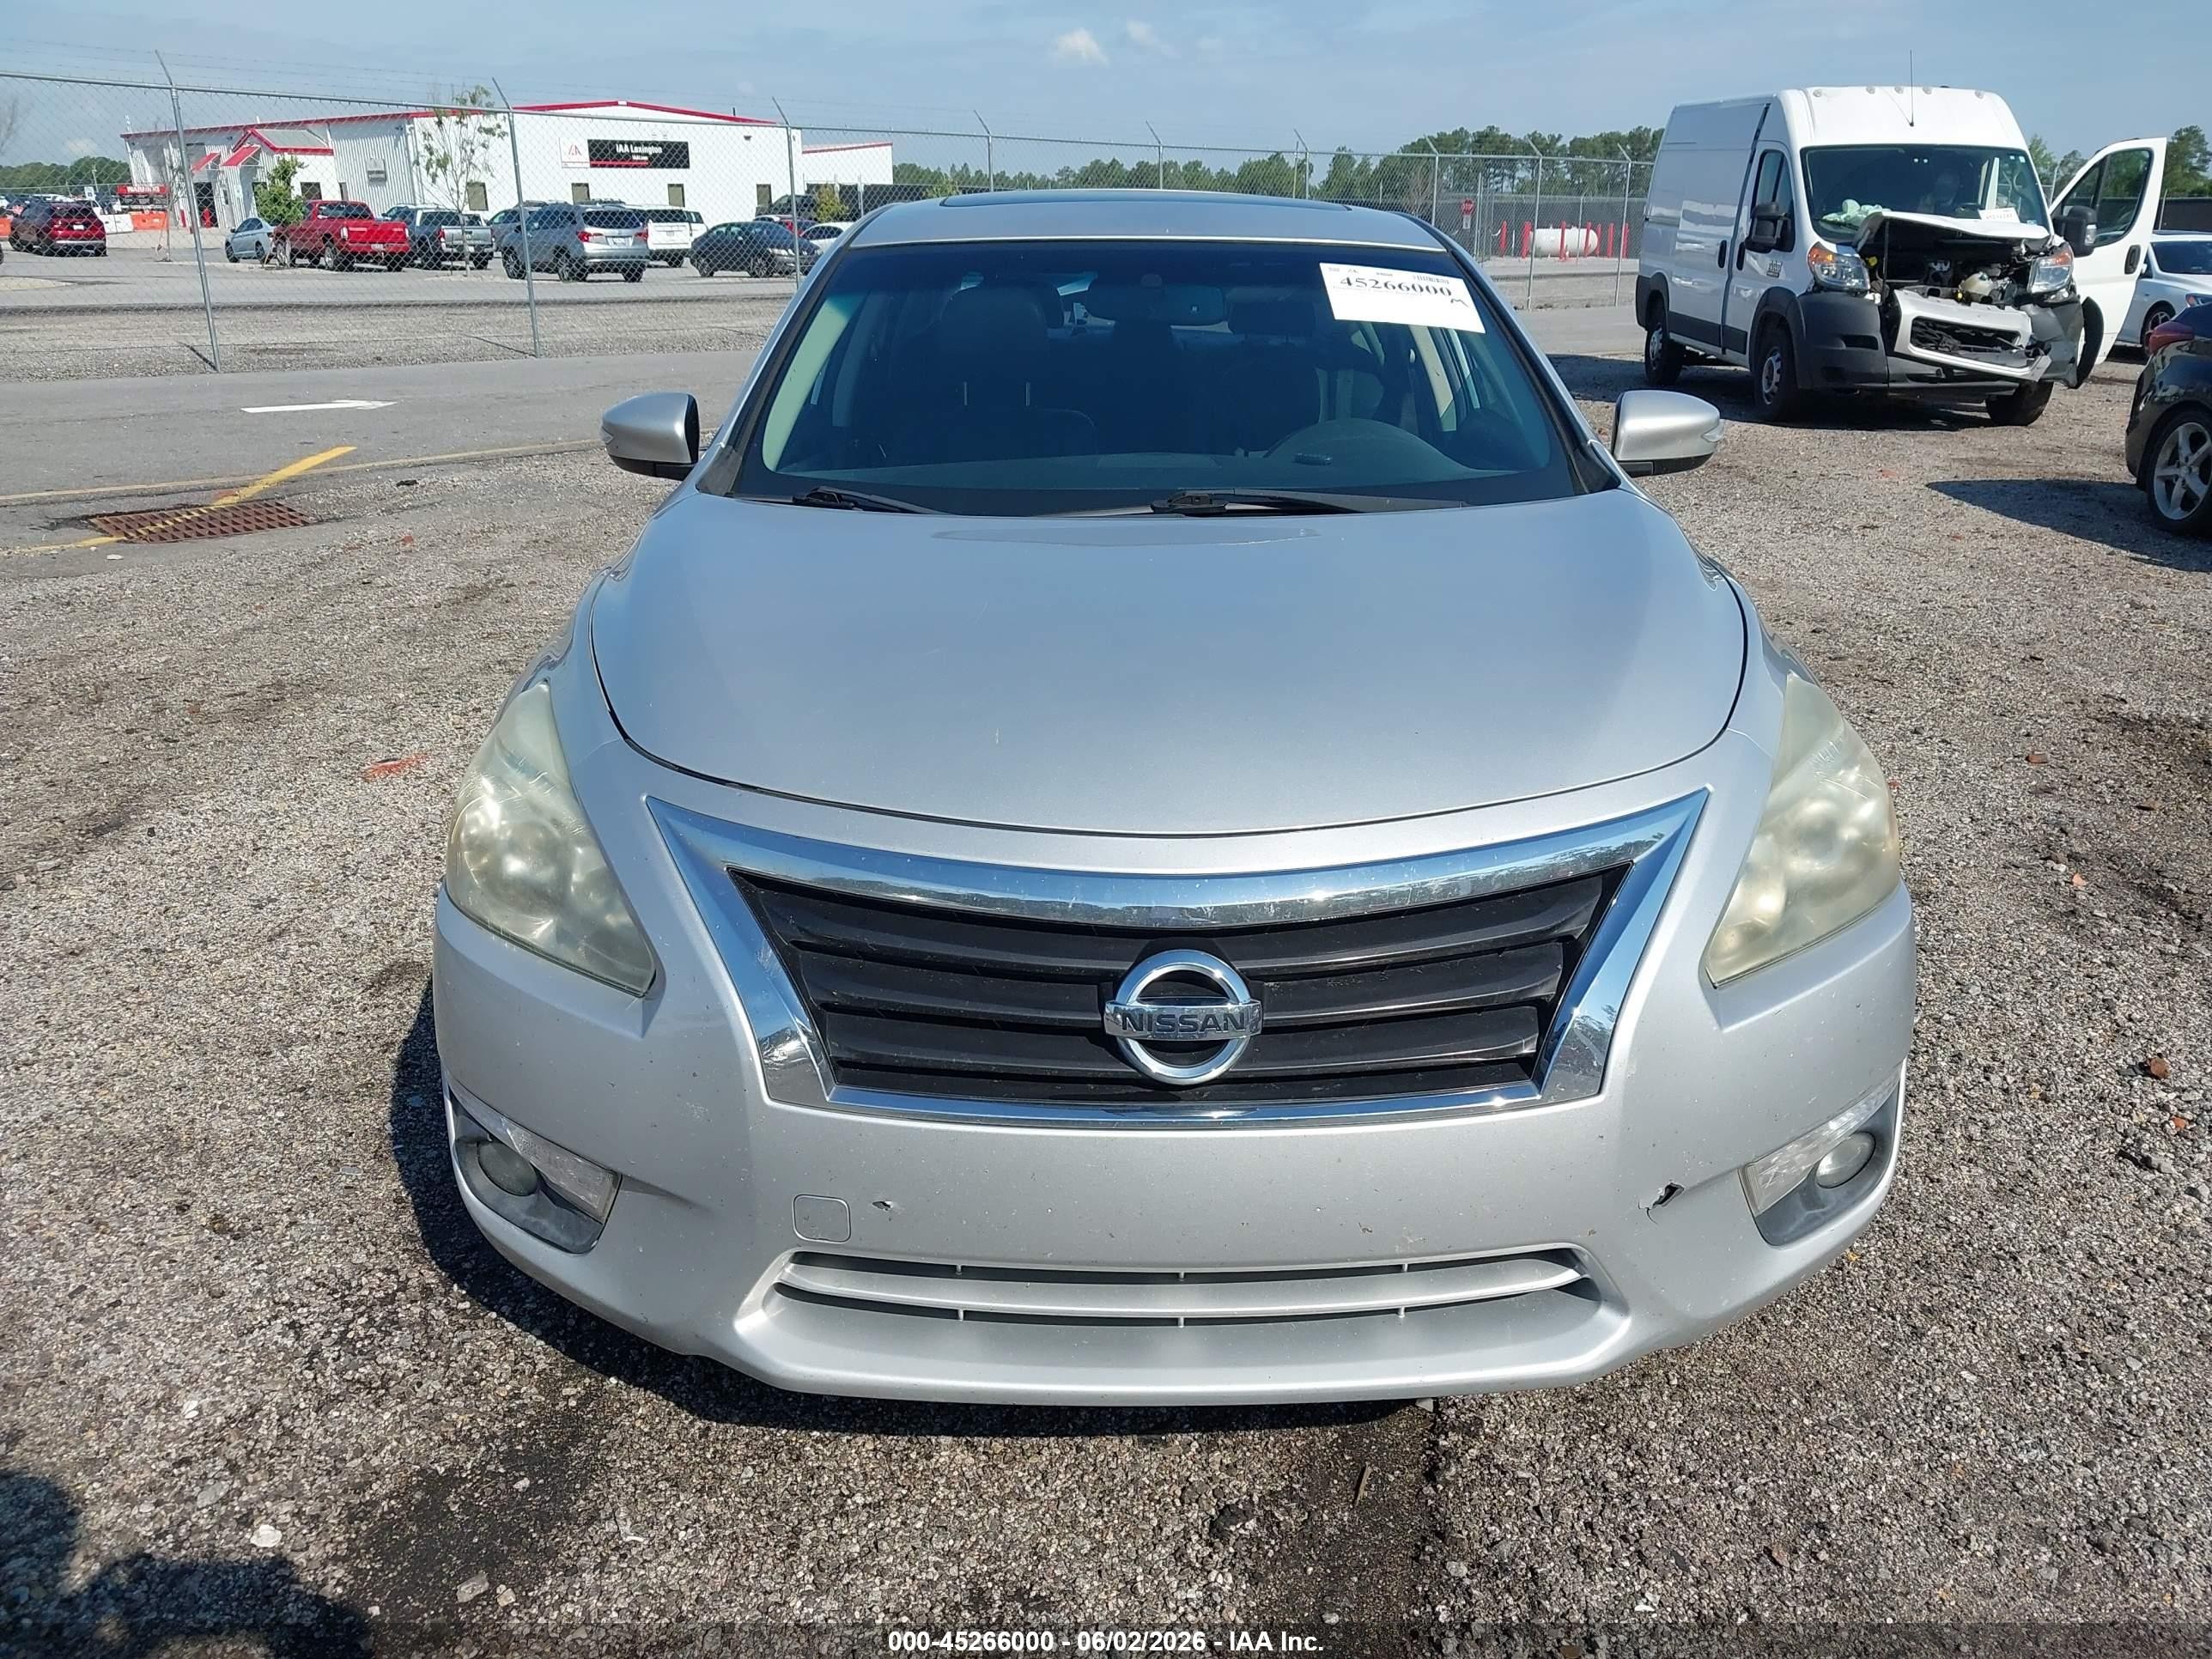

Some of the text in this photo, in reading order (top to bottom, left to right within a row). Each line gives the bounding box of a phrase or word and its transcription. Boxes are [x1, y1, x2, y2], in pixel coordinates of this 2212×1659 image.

[616, 143, 663, 155] IAA Lexington
[1340, 276, 1452, 297] 45266000
[1121, 1012, 1247, 1033] NISSAN
